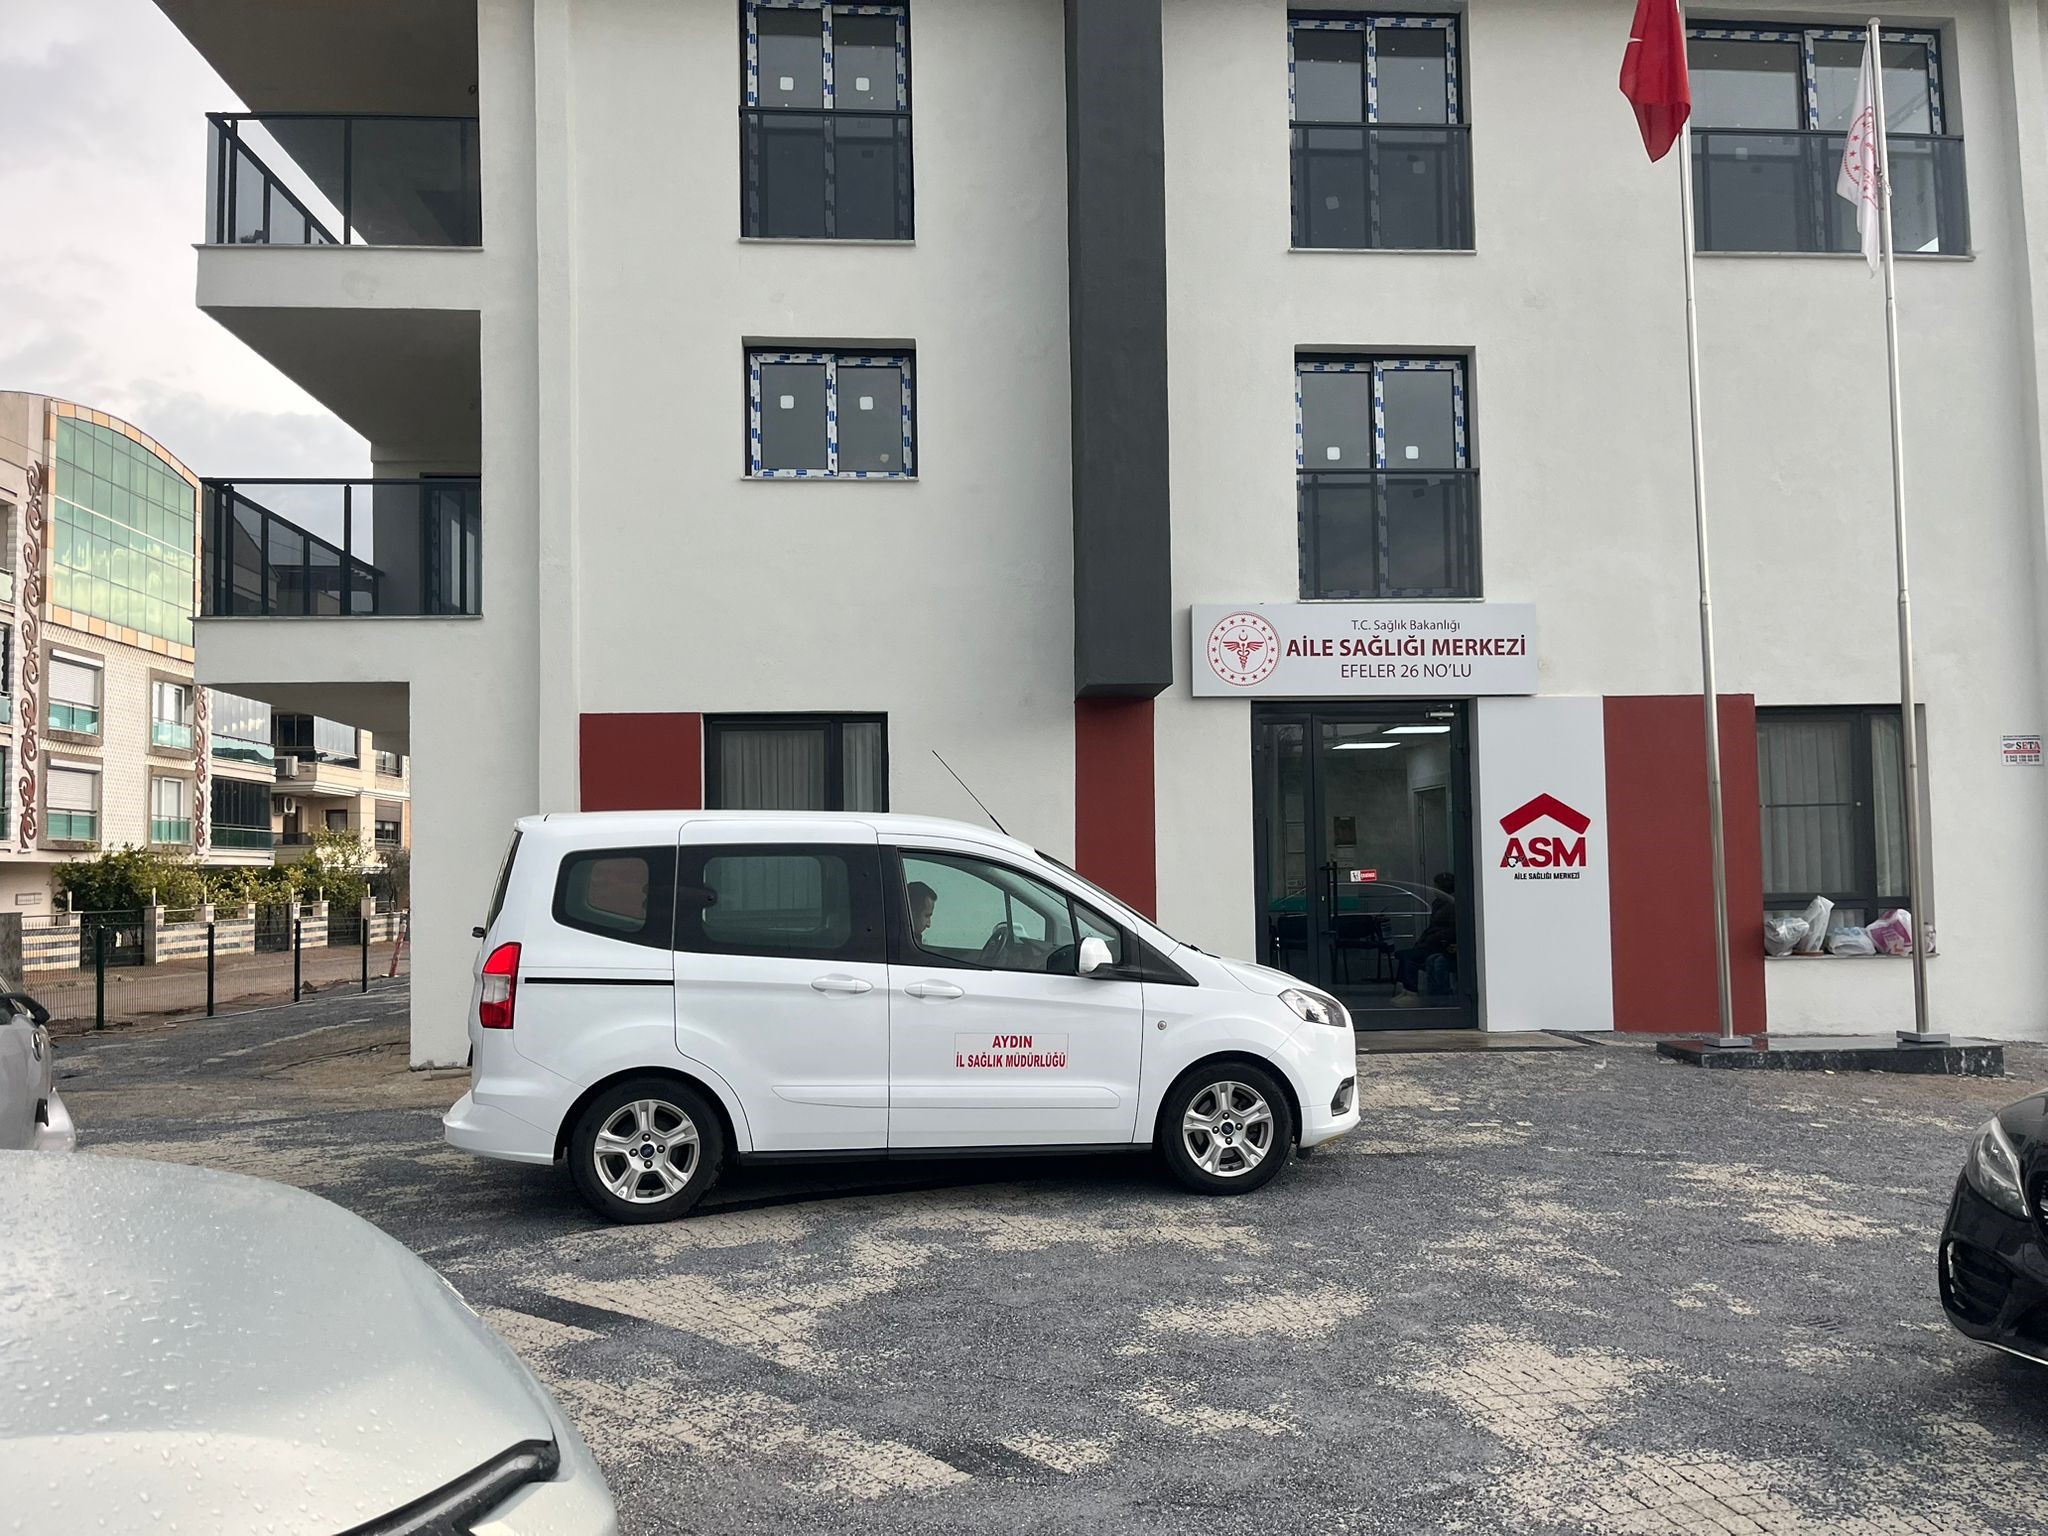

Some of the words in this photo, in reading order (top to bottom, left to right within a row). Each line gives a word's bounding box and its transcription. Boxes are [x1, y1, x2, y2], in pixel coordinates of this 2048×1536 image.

[1351, 620, 1371, 631] T.C.
[1374, 619, 1407, 633] Sağlık
[1410, 618, 1461, 633] Bakanlığı
[1286, 635, 1334, 657] AİLE
[1339, 635, 1425, 657] SAĞLIĞI
[1432, 635, 1526, 656] MERKEZİ
[1341, 664, 1396, 679] EFELER
[1400, 664, 1419, 679] 26
[2015, 741, 2041, 750] SETA
[1500, 837, 1587, 868] ASM
[1514, 872, 1527, 880] AİLE
[1528, 871, 1552, 880] SAĞLIĞI
[1553, 871, 1580, 880] MERKEZİ
[992, 1036, 1033, 1048] AYDIN
[956, 1052, 965, 1067] İL
[968, 1052, 1003, 1067] SAĞLIK
[1005, 1052, 1066, 1067] MÜDÜRLÜĞÜ
